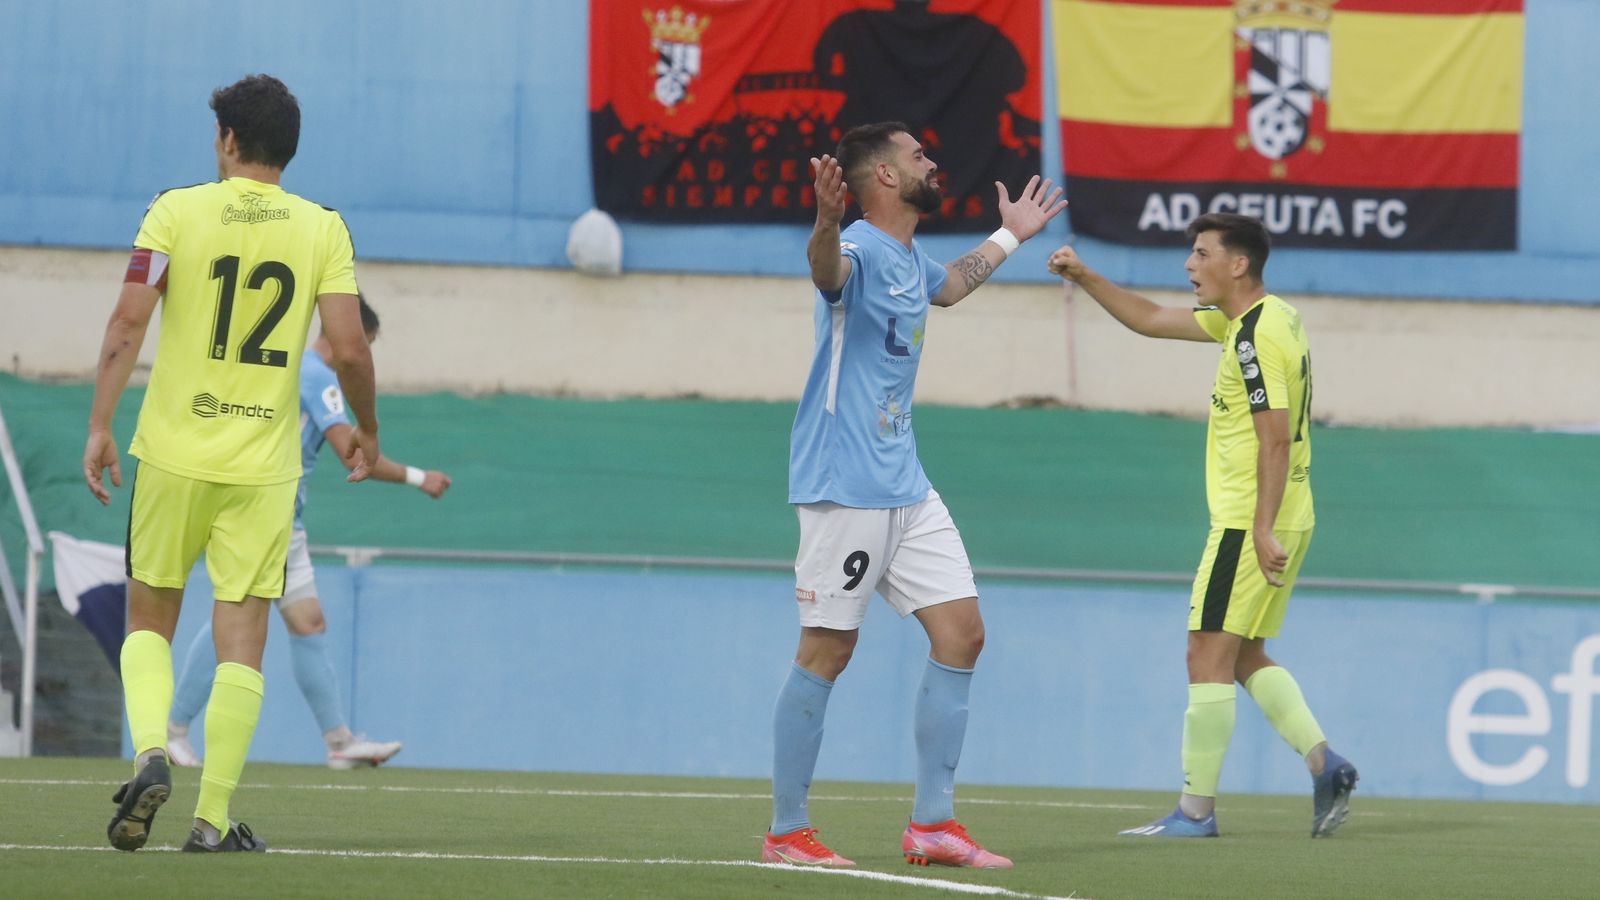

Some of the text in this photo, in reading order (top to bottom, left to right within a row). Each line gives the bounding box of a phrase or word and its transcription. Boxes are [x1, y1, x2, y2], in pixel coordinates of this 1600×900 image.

[677, 159, 725, 182] AD
[1137, 193, 1200, 231] AD
[1352, 198, 1408, 239] FC
[208, 255, 296, 368] 12
[219, 401, 274, 419] smdtc
[842, 550, 870, 592] 9
[1446, 634, 1600, 788] ef
